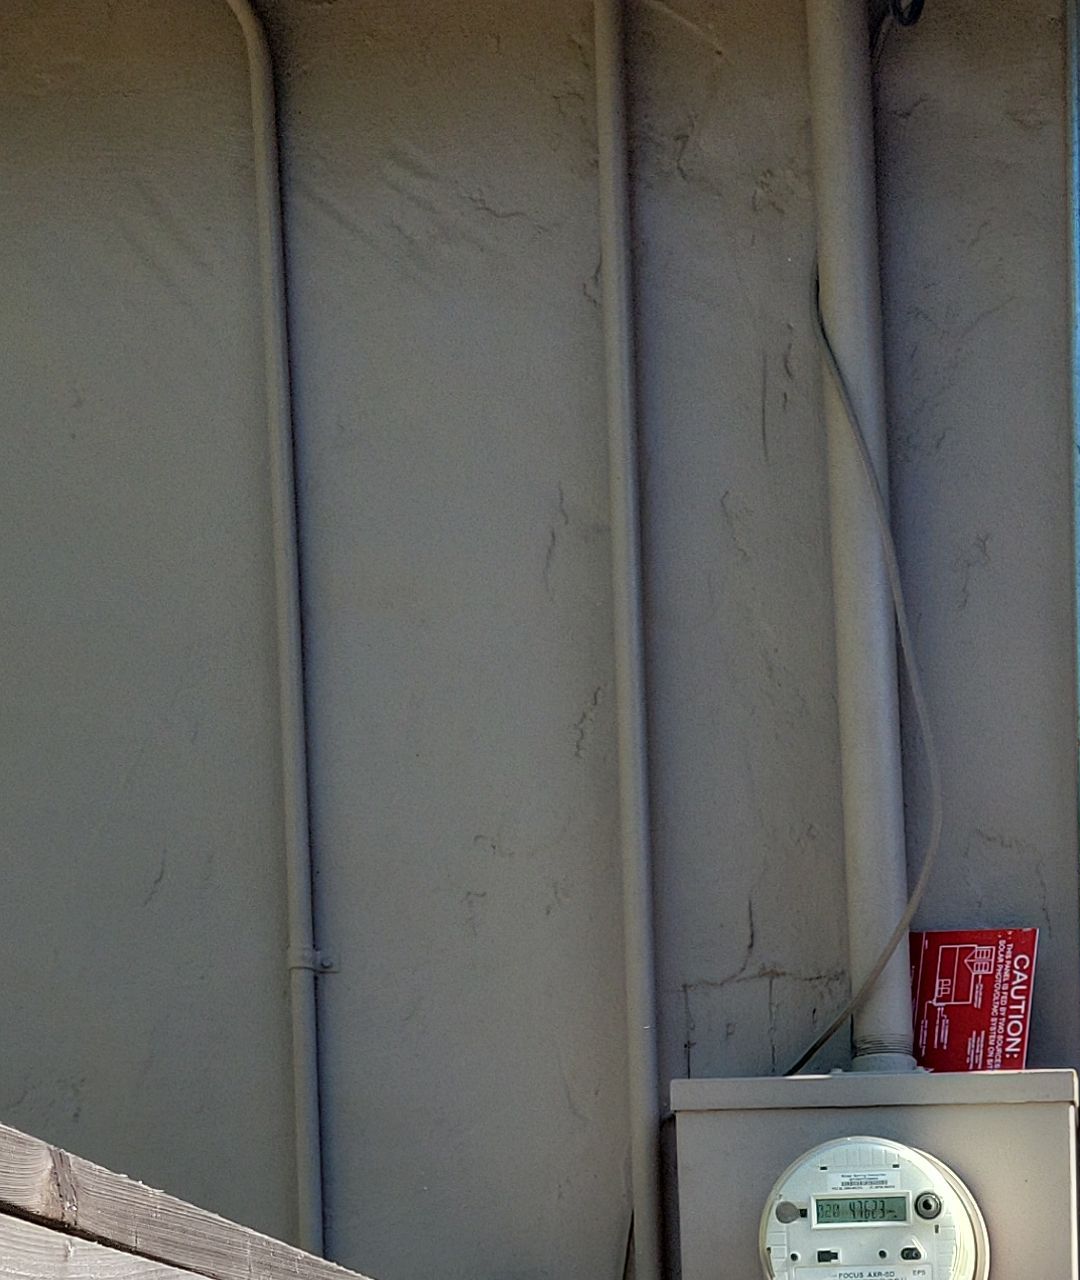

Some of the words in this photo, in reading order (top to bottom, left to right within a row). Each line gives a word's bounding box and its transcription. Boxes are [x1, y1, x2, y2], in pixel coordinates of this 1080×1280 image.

[997, 940, 1005, 963] SOLAR
[1005, 943, 1013, 959] THIS
[1003, 960, 1012, 981] PANEL
[1000, 991, 1008, 1006] FED
[1004, 954, 1030, 1058] CAUTION:
[999, 1007, 1006, 1016] BY
[988, 1017, 998, 1045] SYSTEM
[997, 1017, 1005, 1033] TWO
[987, 1046, 995, 1057] ON
[994, 1034, 1003, 1068] SOURCES
[986, 1058, 994, 1070] SIT
